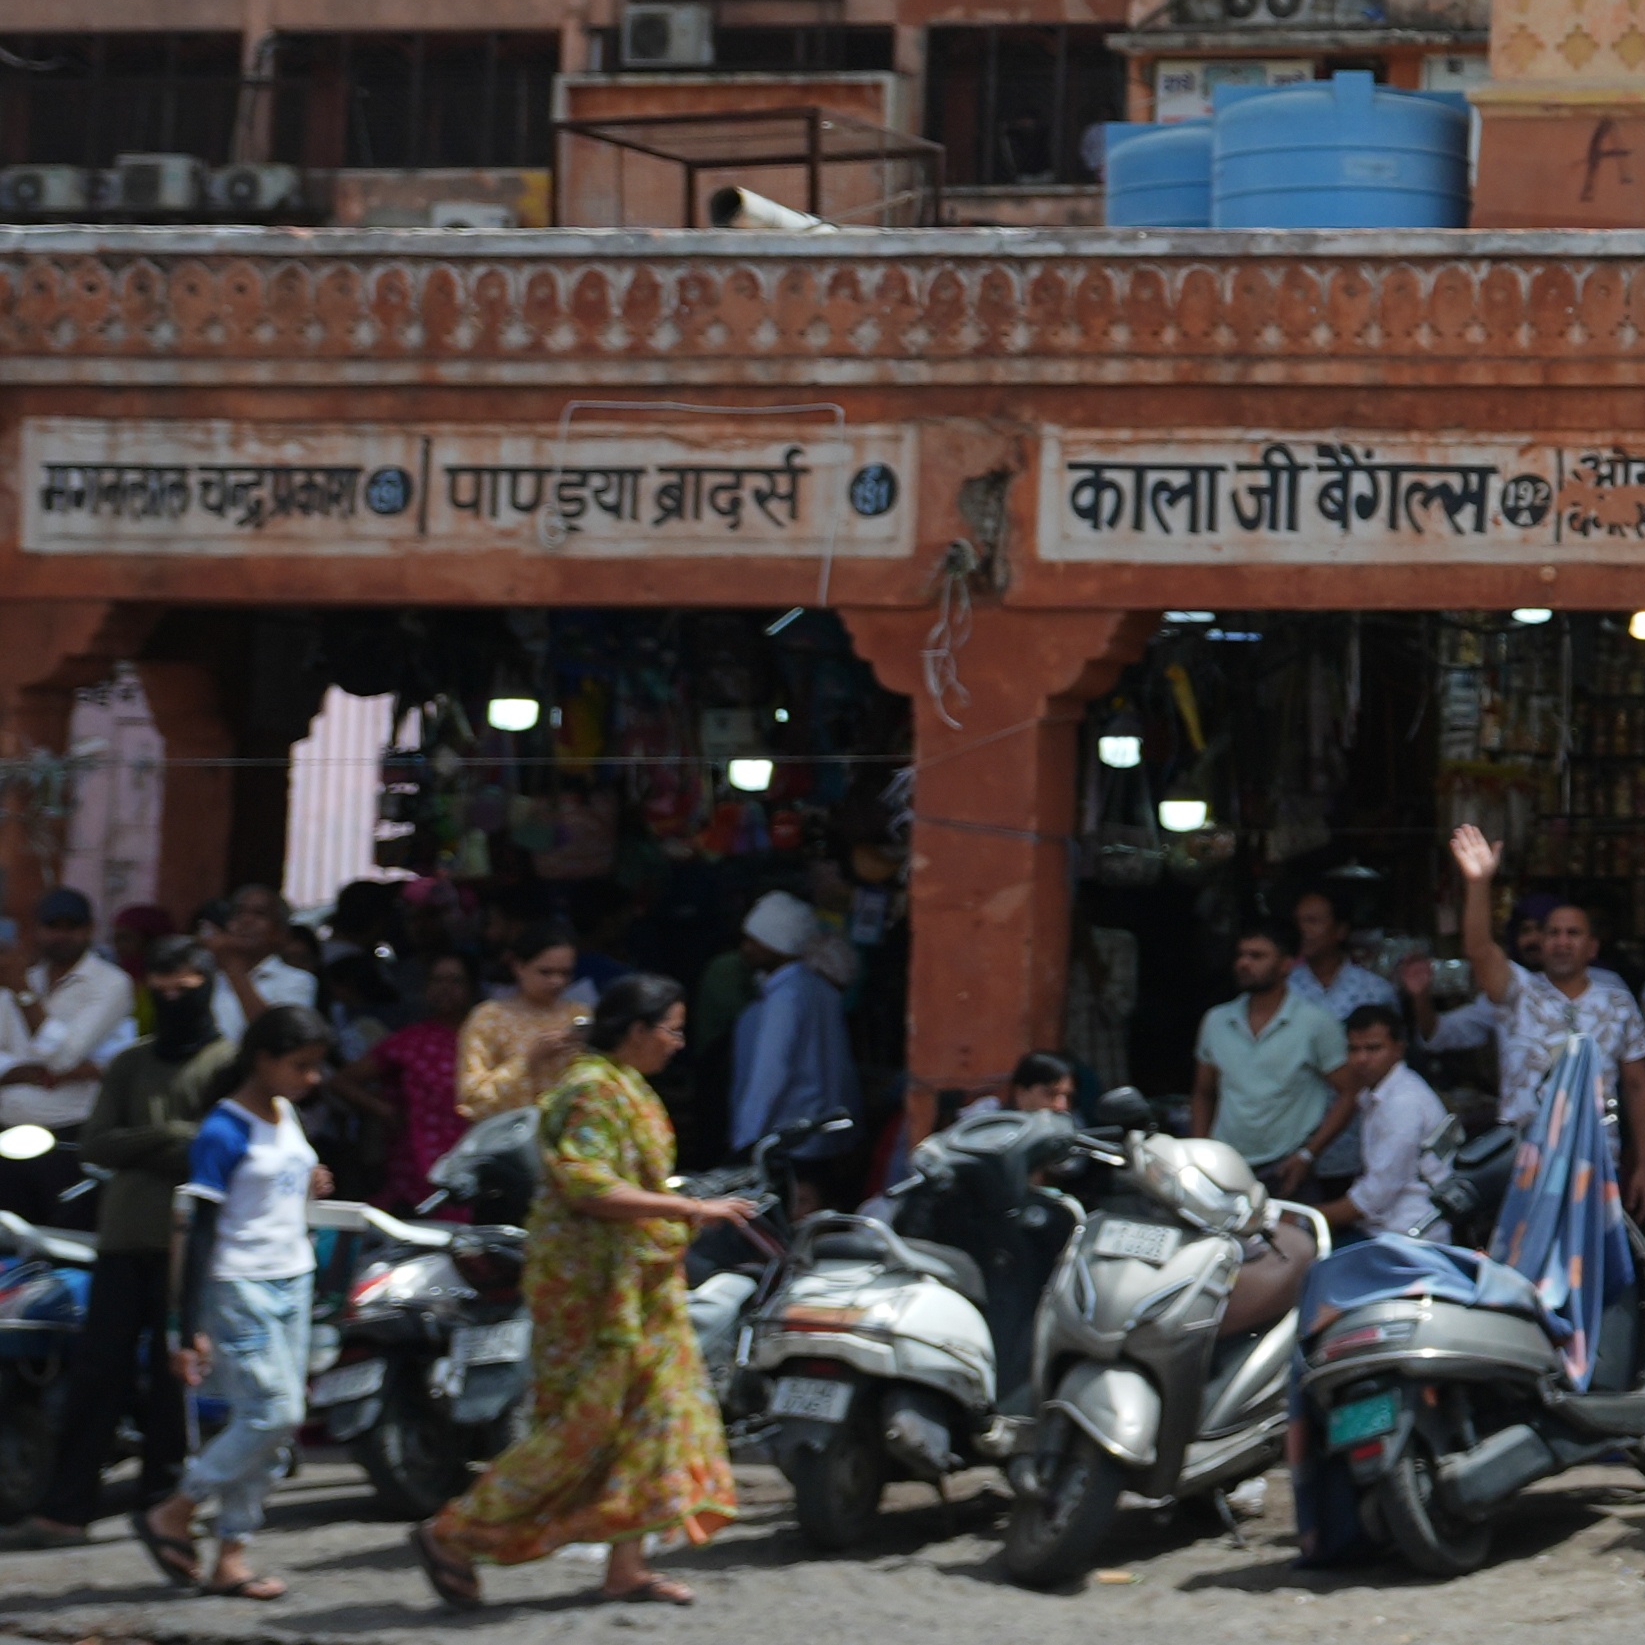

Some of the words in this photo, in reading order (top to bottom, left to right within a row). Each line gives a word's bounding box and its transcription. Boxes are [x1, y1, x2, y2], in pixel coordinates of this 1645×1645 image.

[653, 444, 809, 529] ब्रादर्स
[1067, 462, 1226, 535] काला
[1232, 443, 1309, 533] जी
[1316, 443, 1498, 535] बैंगल्स
[1504, 480, 1550, 507] 192
